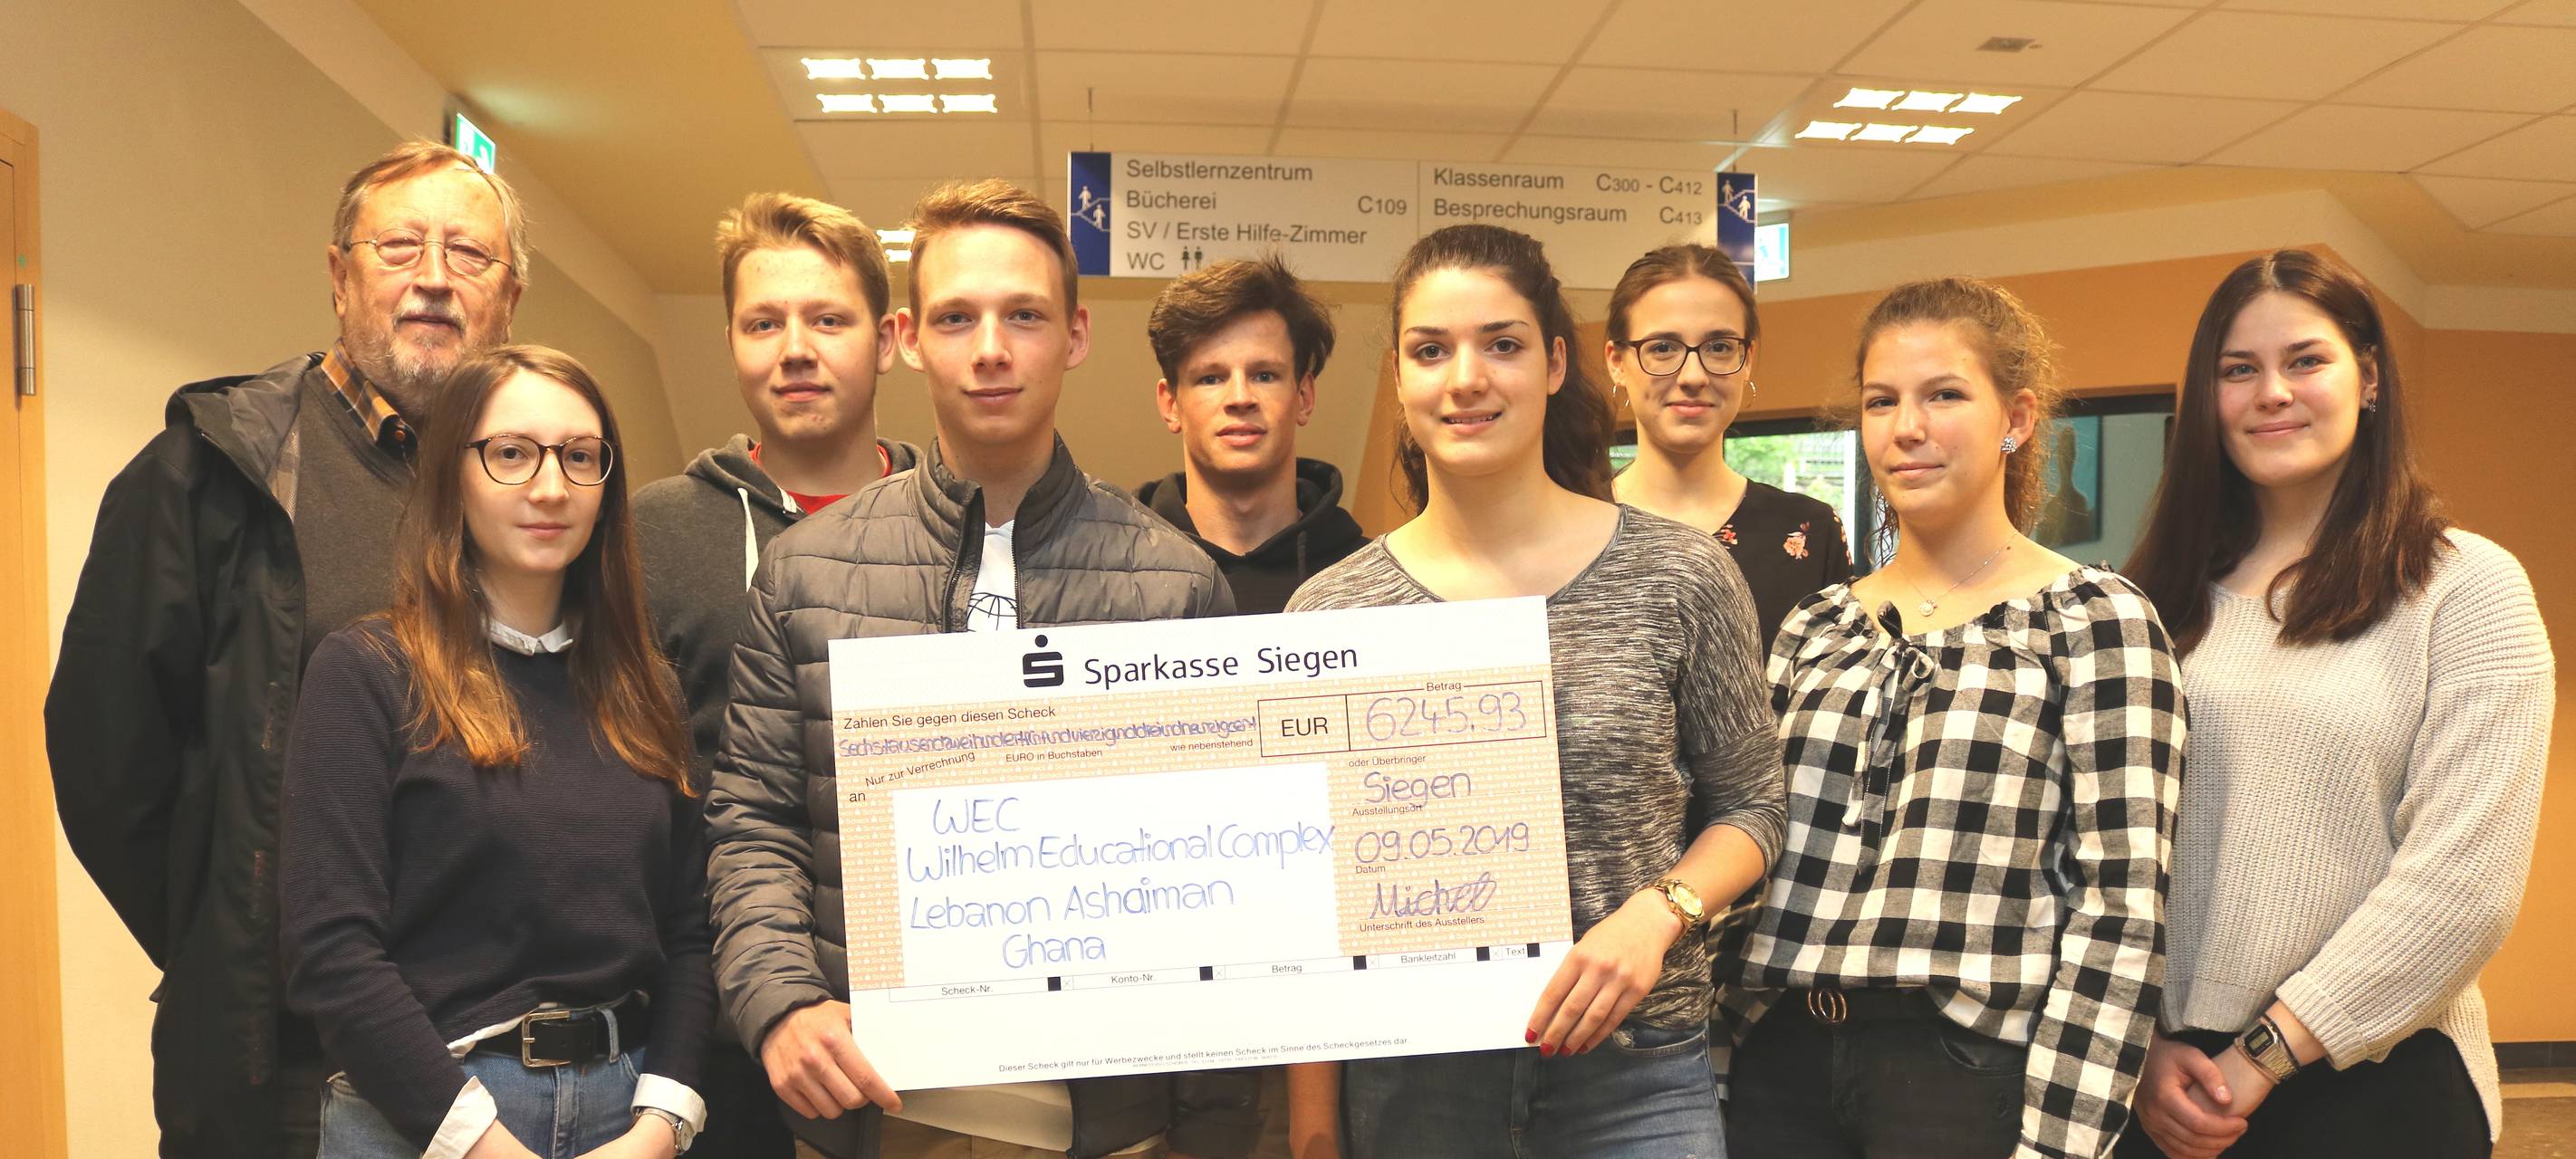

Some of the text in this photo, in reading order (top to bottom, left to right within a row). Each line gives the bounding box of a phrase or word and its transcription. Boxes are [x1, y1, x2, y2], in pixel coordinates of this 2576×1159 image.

[1126, 158, 1313, 181] Selbstlernzentrum
[1433, 167, 1565, 190] Klassenraum
[1596, 173, 1640, 194] C300
[1658, 175, 1703, 196] C412
[1126, 189, 1408, 216] Bücherei C109
[1433, 197, 1704, 226] Besprechungsraum C413
[1126, 220, 1158, 240] SV
[1177, 222, 1230, 242] Erste
[1236, 224, 1368, 245] Hilfe-Zimmer
[1126, 251, 1166, 271] WC
[1085, 646, 1359, 690] Sparkasse Siegen
[1426, 681, 1462, 693] Betrag
[843, 705, 1056, 731] Zahlen Sie gegen diesen Scheck
[1280, 716, 1329, 738] EUR
[1365, 691, 1528, 742] 6245.93
[1004, 748, 1103, 763] EURO in Buchstaben
[1169, 738, 1254, 752] wie nebenstehend
[865, 751, 976, 787] Nur zur Verrechnung
[1348, 753, 1427, 768] oder Überbringer
[849, 790, 866, 803] an
[1362, 771, 1472, 809] Siegen
[933, 796, 1022, 836] WEC
[1352, 802, 1423, 817] Ausstellungsort
[907, 820, 1336, 883] Wilhelm Educational Complex
[1354, 821, 1530, 864] 09.05.2019
[1355, 863, 1387, 876] Datum
[909, 876, 1235, 930] Lebanon Ashaiman
[1359, 915, 1486, 934] Unterschrift des Ausstellers
[1002, 932, 1108, 970] Ghana
[1400, 951, 1457, 964] Bankleitzahl
[1504, 946, 1527, 957] Text
[1110, 972, 1158, 984] Konto-Nr.
[1271, 963, 1303, 975] Betrag
[940, 984, 995, 997] Scheck-Nr.
[998, 1063, 1026, 1073] Dieser
[1027, 1060, 1059, 1071] Scheck
[1061, 1059, 1074, 1069] gilt
[1076, 1059, 1090, 1068] nur
[1104, 1054, 1164, 1066] Werbezwecke
[1165, 1051, 1182, 1061] und
[1206, 1049, 1234, 1058] keinen
[1235, 1047, 1266, 1057] Scheck
[1280, 1043, 1304, 1053] Sinne
[1305, 1041, 1322, 1051] des
[1322, 1038, 1392, 1050] Scheckgesetzes
